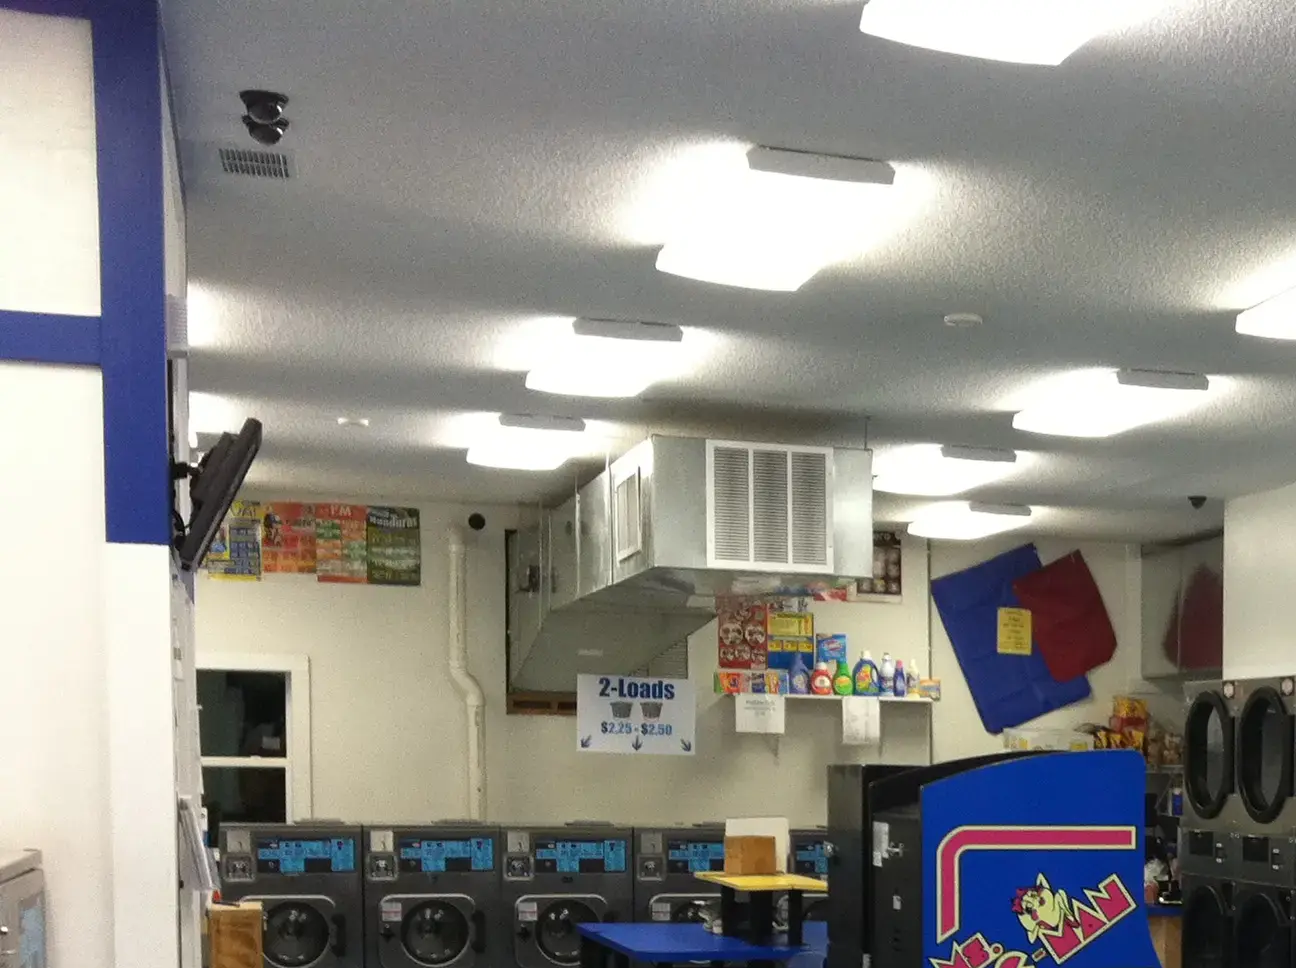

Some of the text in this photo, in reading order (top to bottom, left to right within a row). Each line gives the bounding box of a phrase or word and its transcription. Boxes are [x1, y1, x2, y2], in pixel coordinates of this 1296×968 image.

[599, 677, 675, 700] 2-Loads
[601, 721, 632, 735] $2.25
[641, 722, 673, 736] $2.50
